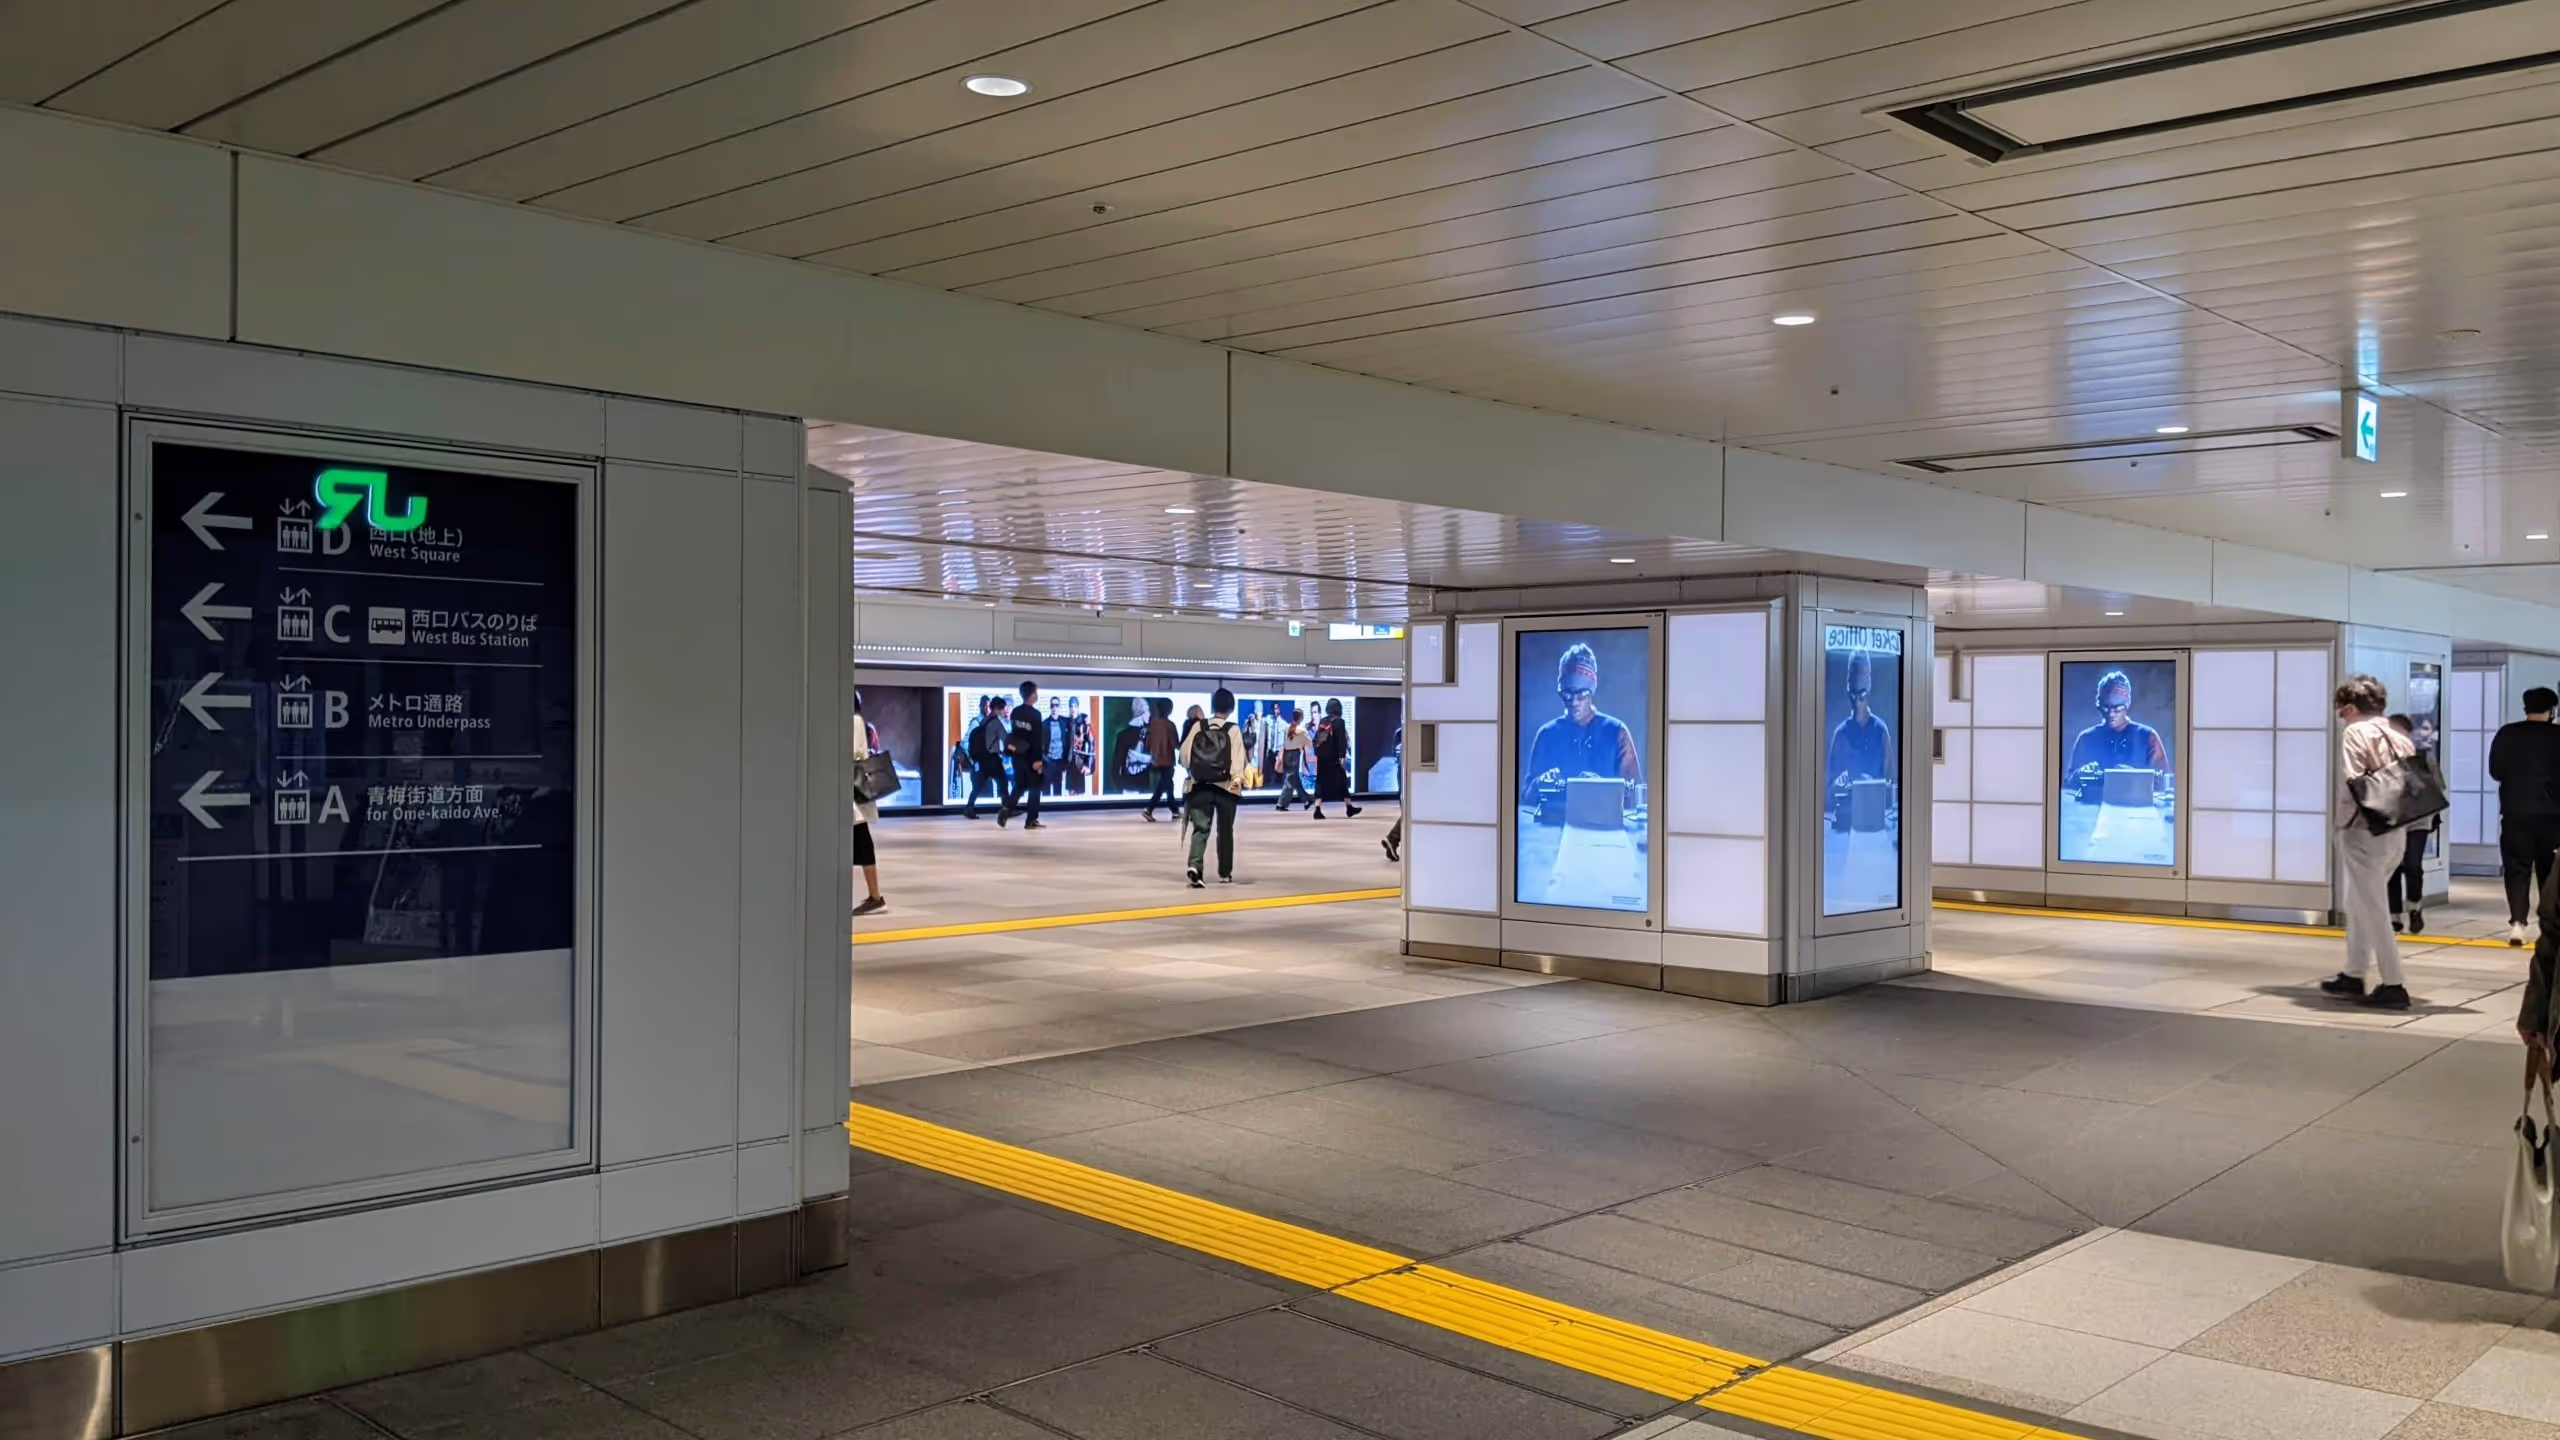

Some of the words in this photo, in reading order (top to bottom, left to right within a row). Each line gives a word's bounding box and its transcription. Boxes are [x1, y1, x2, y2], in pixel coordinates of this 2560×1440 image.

[322, 520, 351, 555] D
[369, 544, 406, 559] West
[411, 546, 461, 564] Square
[324, 604, 351, 643] C
[411, 609, 538, 632] 西口バスのりば
[411, 630, 448, 644] West
[452, 631, 476, 645] Bus
[479, 632, 529, 647] Station
[325, 690, 349, 728] B
[368, 693, 463, 713] メトロ通路
[368, 714, 413, 728] Metro
[417, 715, 491, 731] Underpass
[318, 785, 350, 823] A
[367, 785, 483, 805] 青梅街道方面
[367, 807, 388, 821] for
[393, 806, 470, 820] Ome-kaido
[473, 807, 502, 819] Ave.
